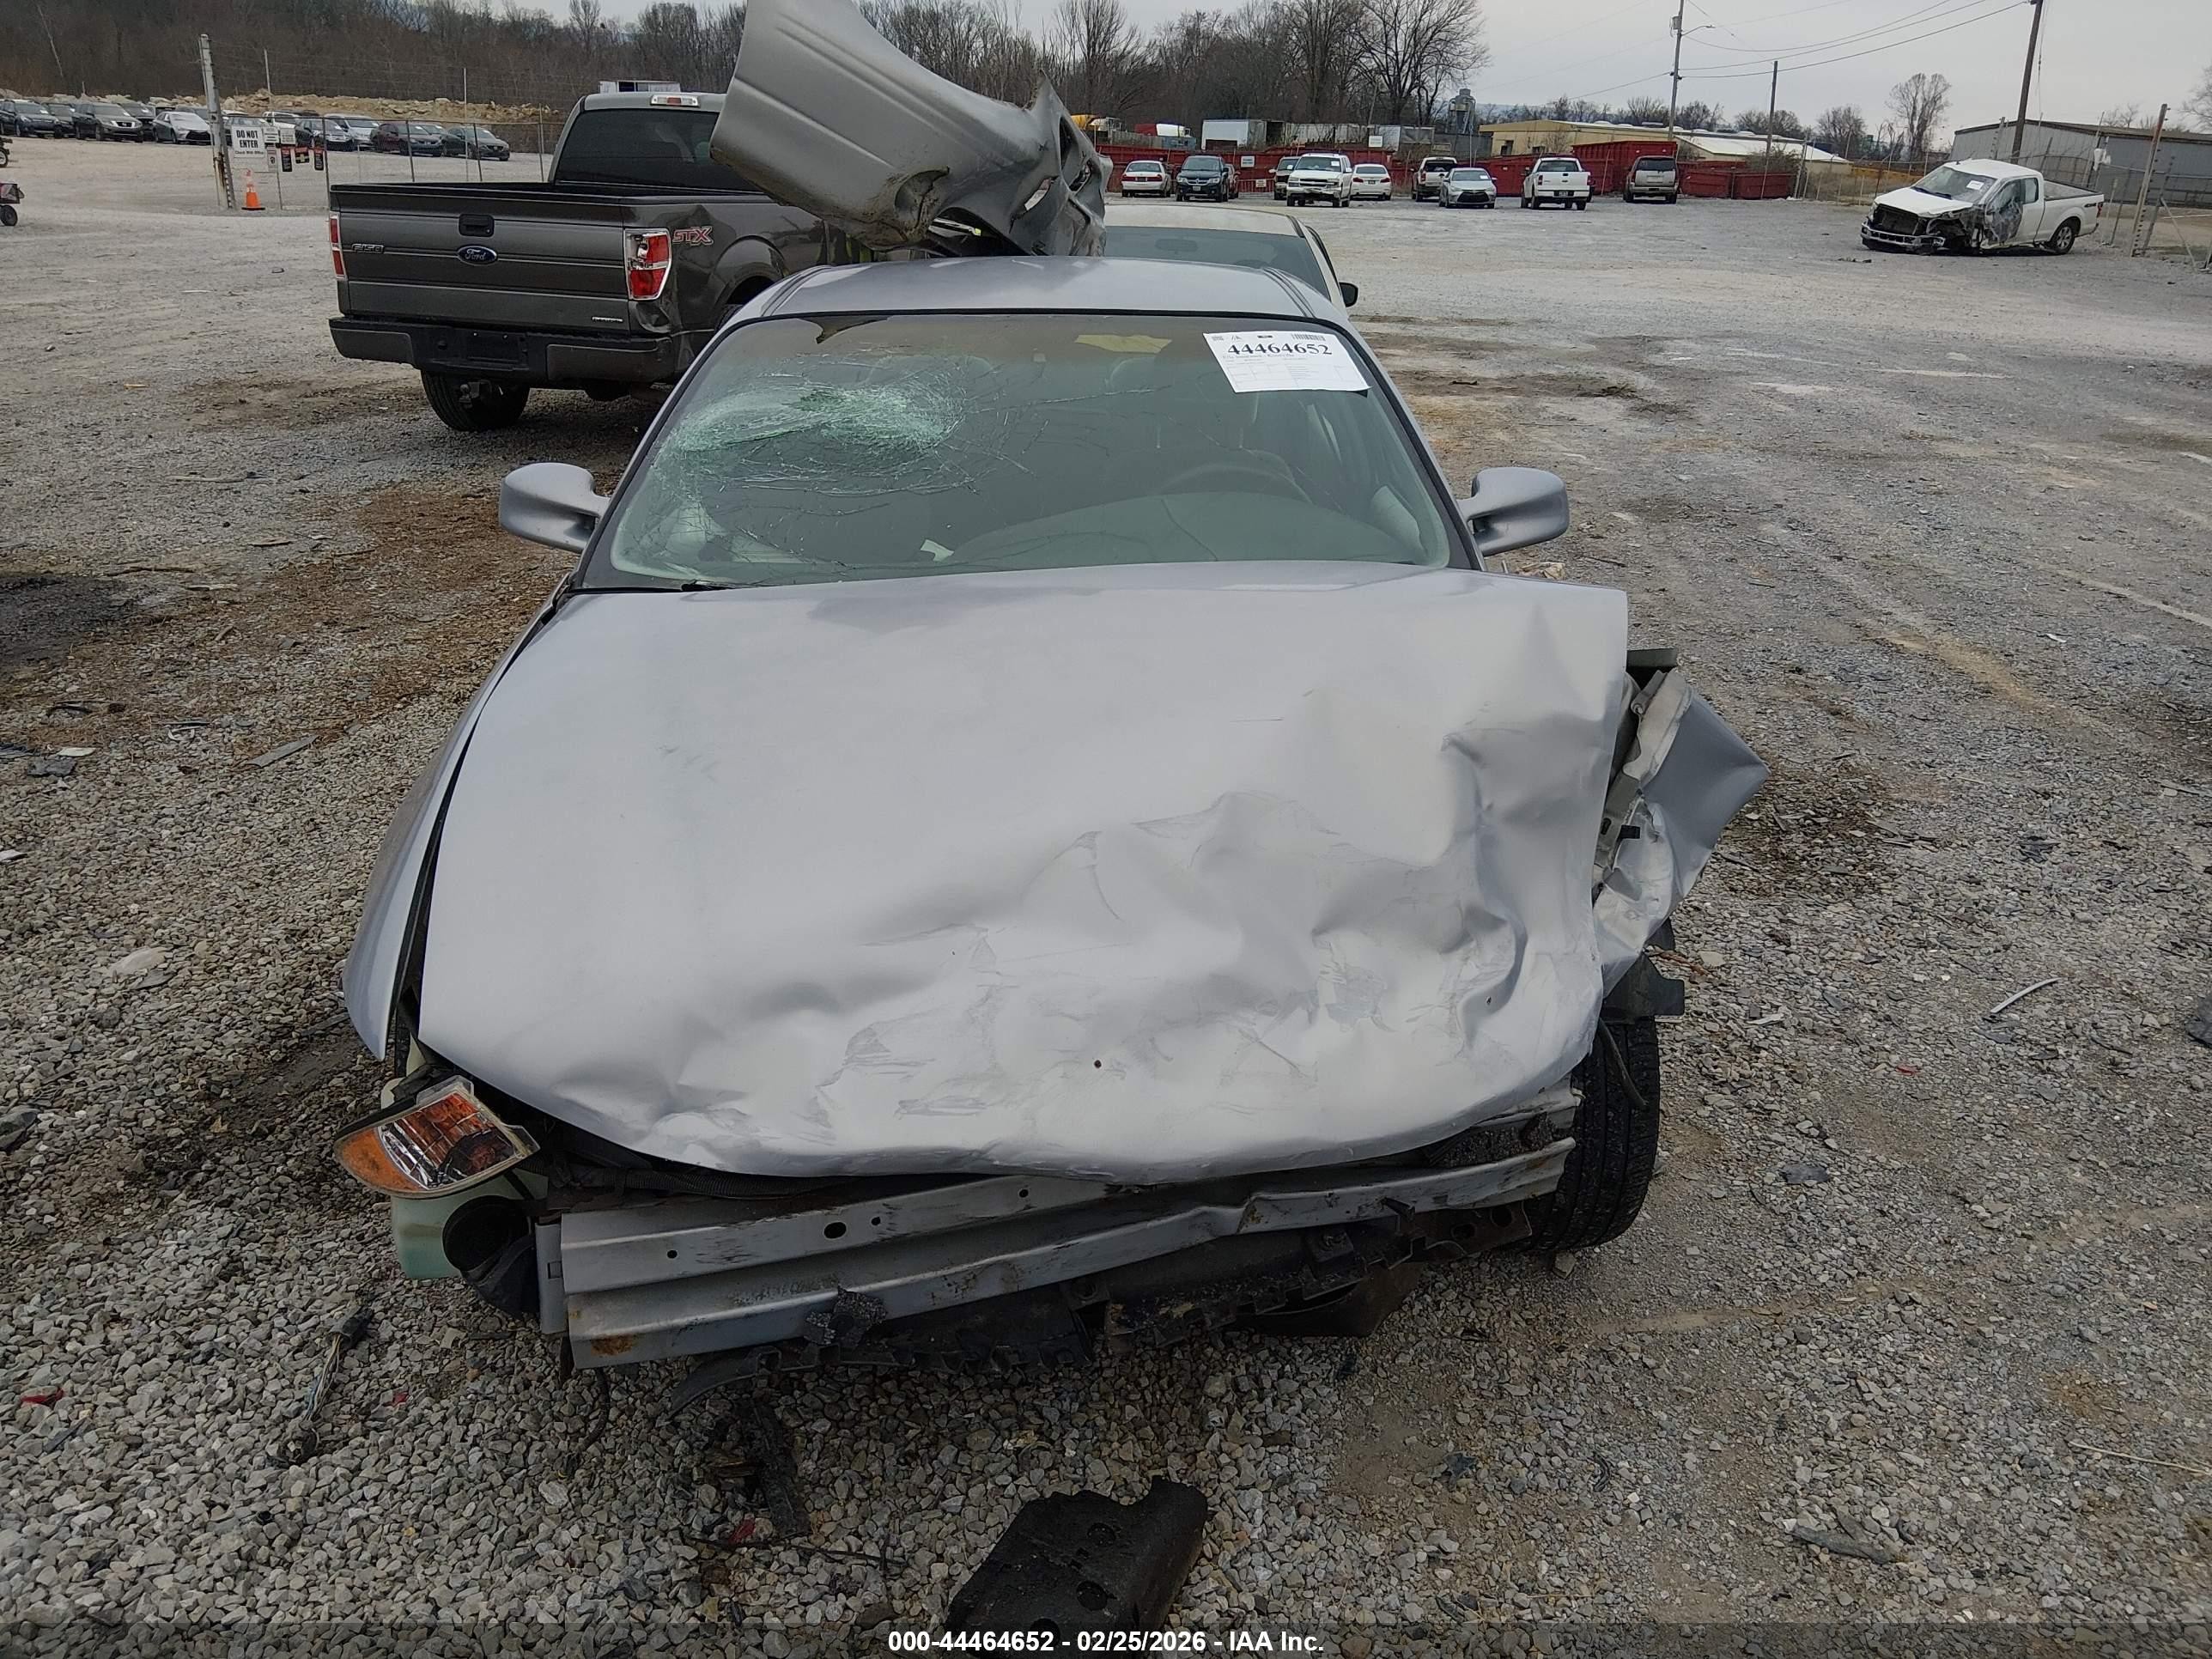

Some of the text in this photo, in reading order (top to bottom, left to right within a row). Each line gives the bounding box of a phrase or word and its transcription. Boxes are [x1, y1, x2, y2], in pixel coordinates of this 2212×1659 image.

[236, 130, 246, 138] DO
[246, 130, 258, 139] NOT
[240, 140, 258, 149] ENTER
[672, 225, 714, 246] STX
[464, 247, 487, 260] Ford
[1228, 343, 1333, 355] 44464652
